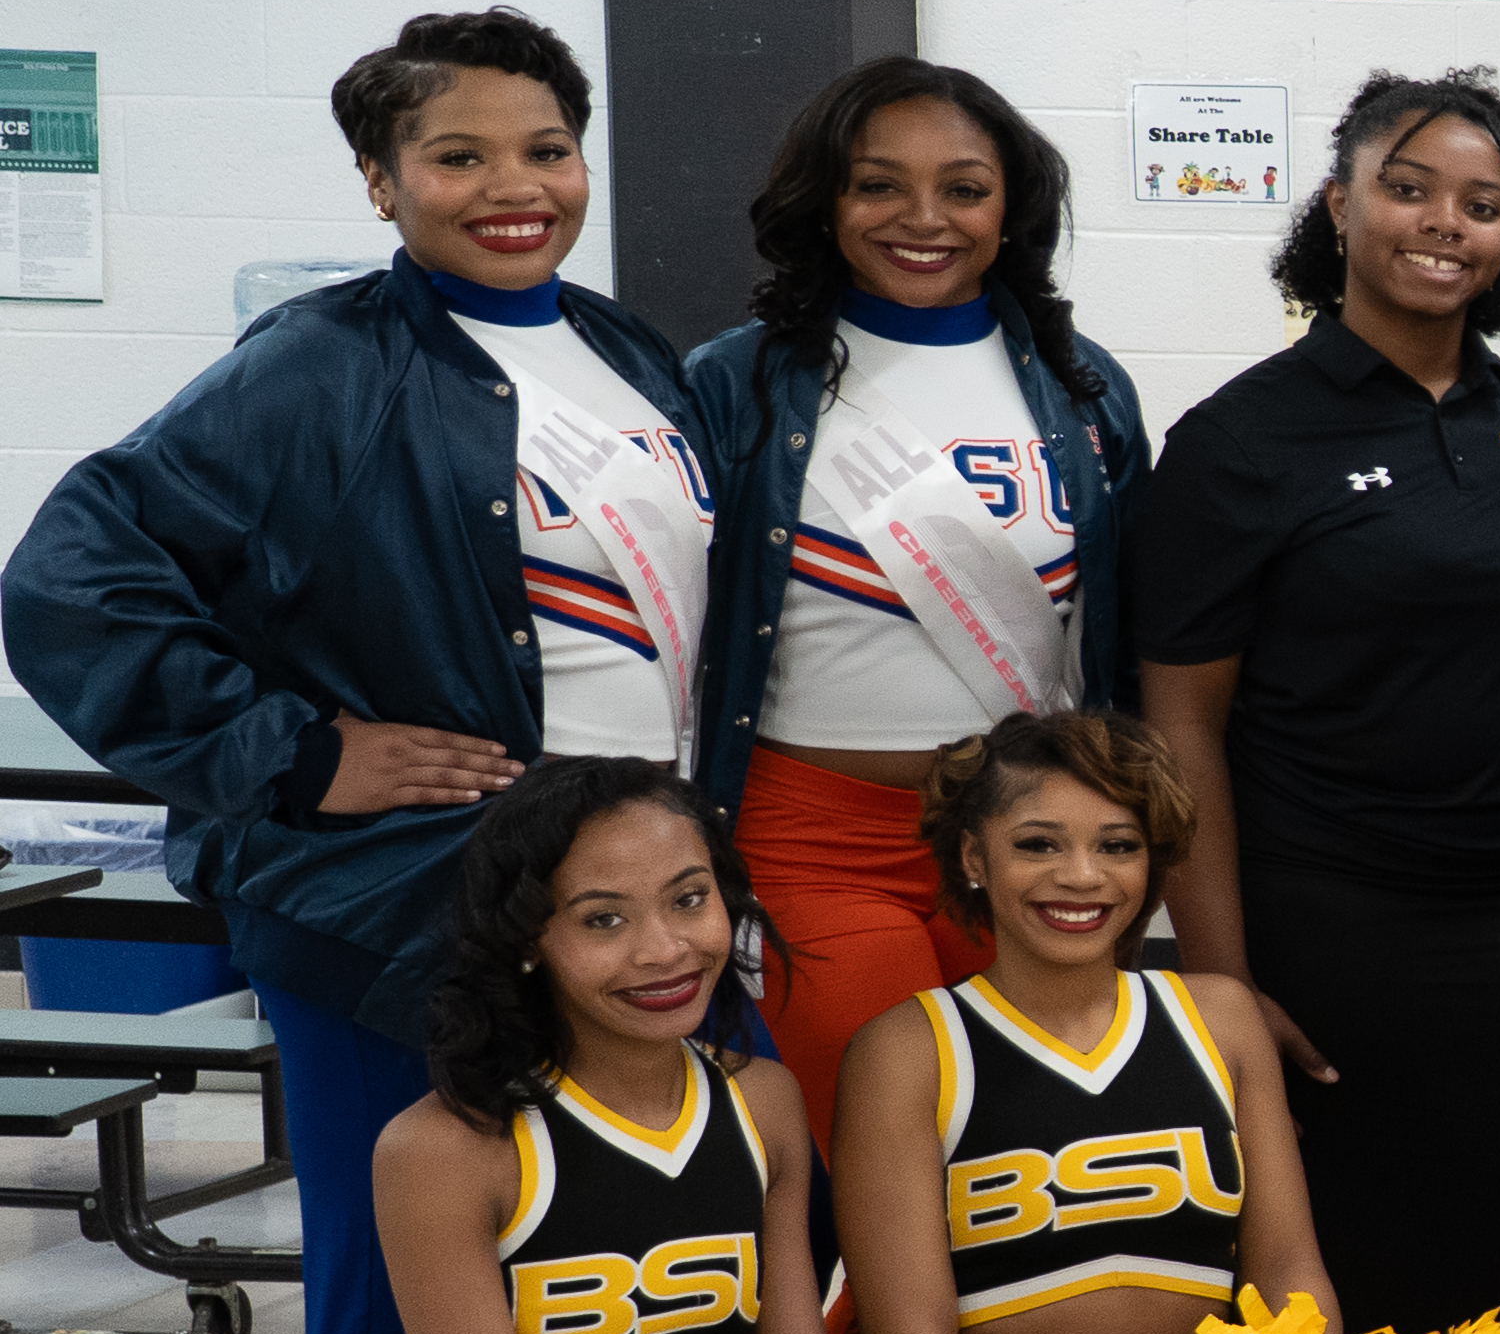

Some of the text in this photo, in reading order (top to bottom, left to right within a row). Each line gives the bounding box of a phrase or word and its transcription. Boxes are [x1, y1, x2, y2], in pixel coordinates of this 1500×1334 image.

[1149, 127, 1274, 144] Share Table
[530, 410, 621, 495] ALL
[830, 424, 937, 513] ALL
[948, 1126, 1243, 1251] BSU
